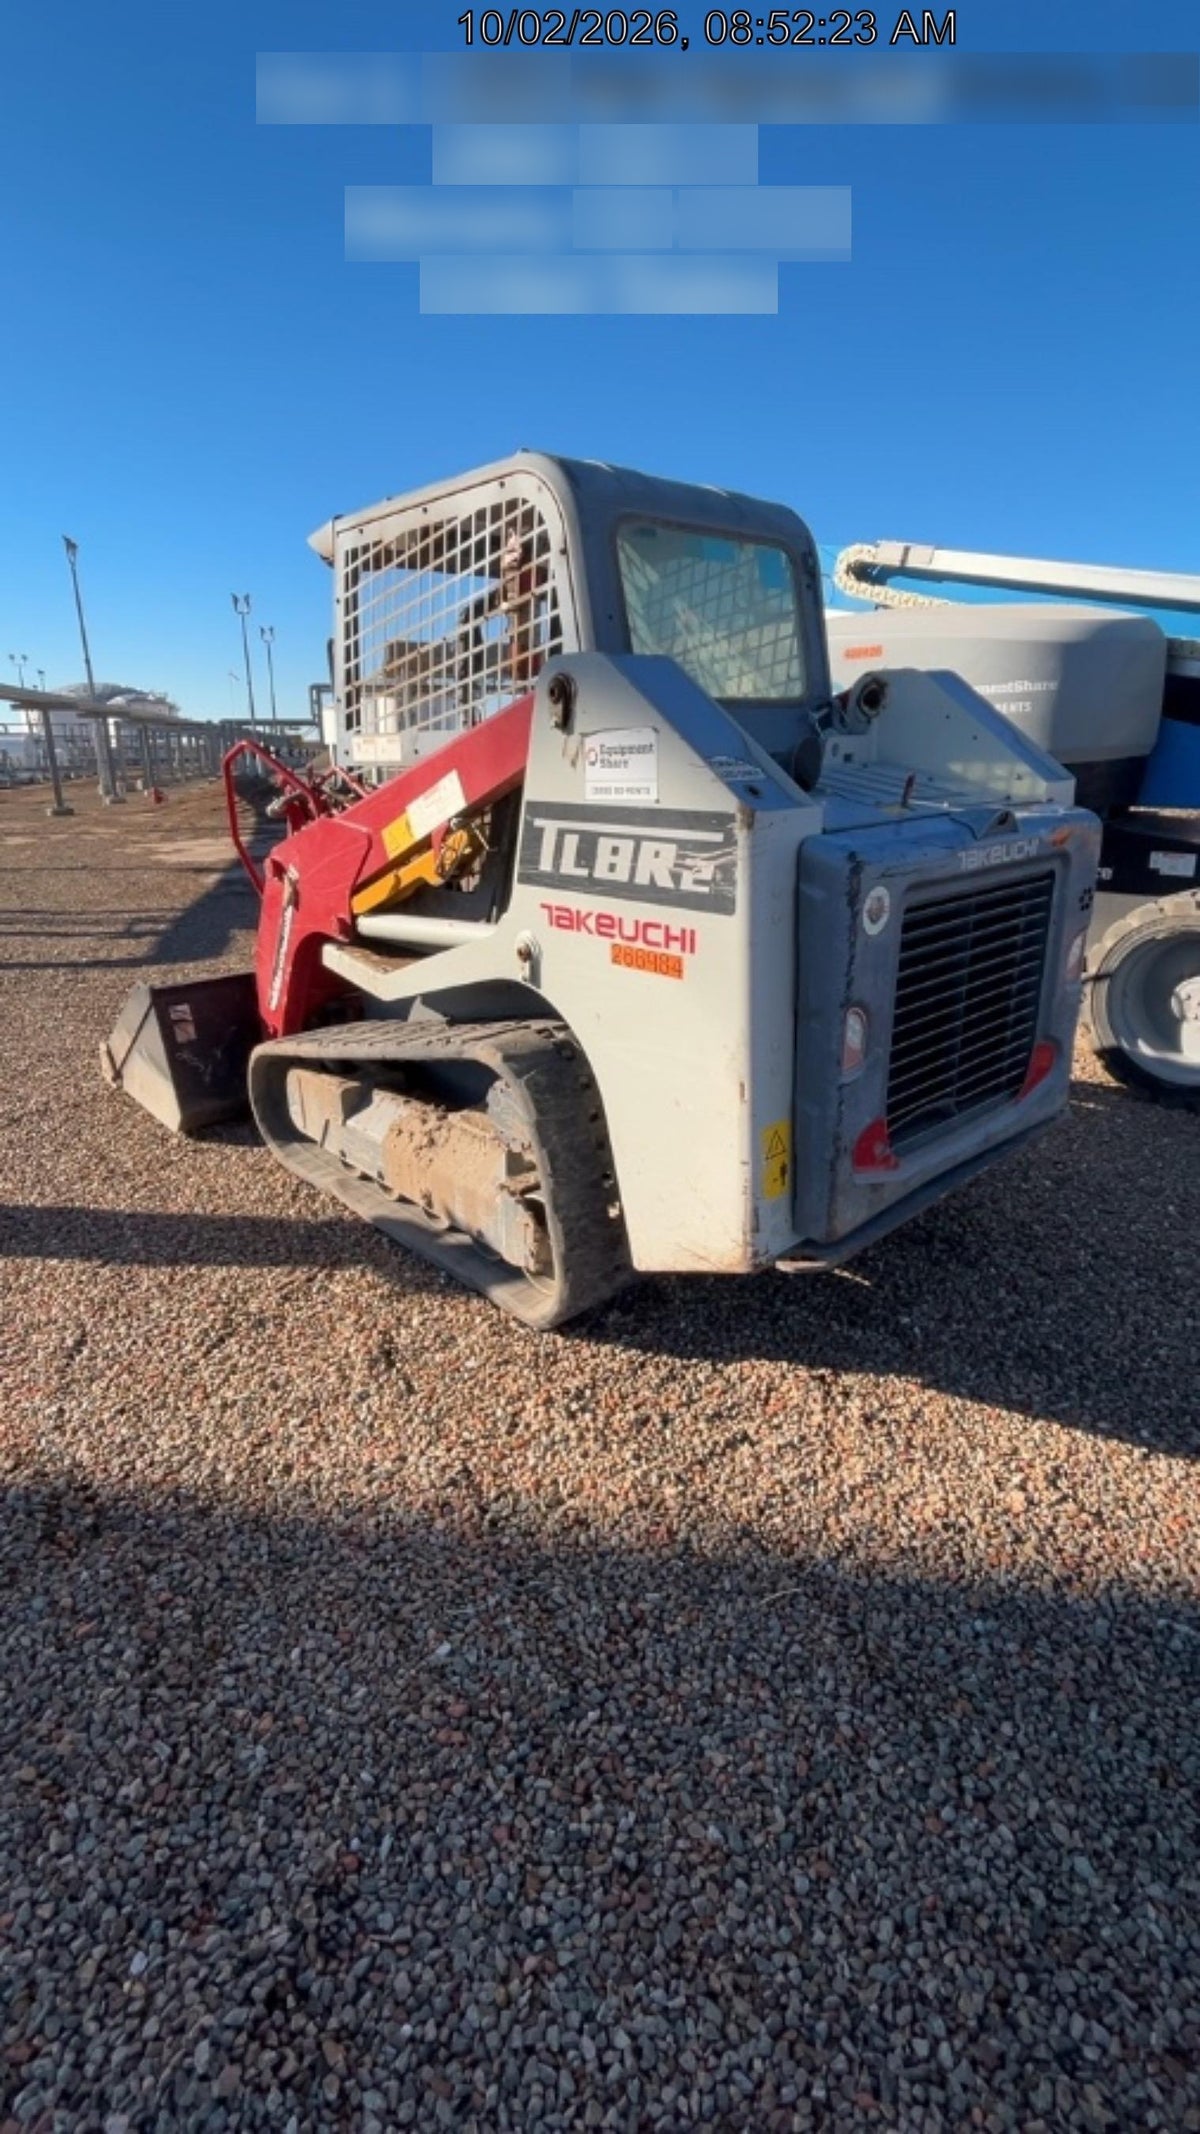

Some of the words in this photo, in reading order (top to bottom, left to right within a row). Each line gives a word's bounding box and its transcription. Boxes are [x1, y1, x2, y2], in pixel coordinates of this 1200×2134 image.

[599, 743, 655, 757] Equipment
[599, 758, 629, 769] Share
[540, 903, 696, 954] TAKEUCHI
